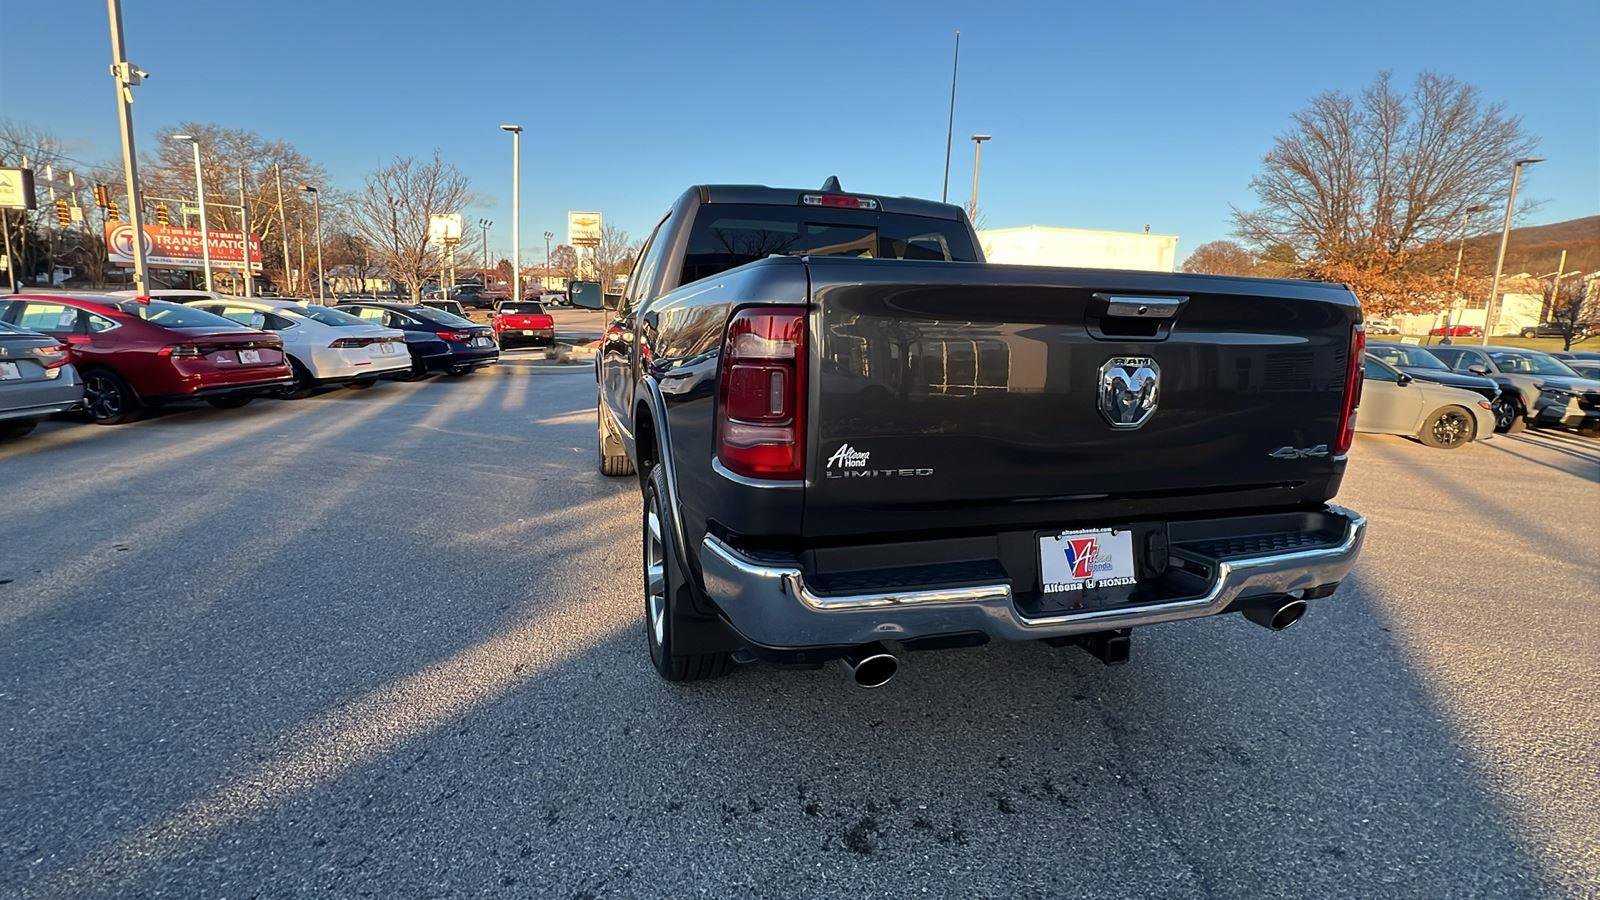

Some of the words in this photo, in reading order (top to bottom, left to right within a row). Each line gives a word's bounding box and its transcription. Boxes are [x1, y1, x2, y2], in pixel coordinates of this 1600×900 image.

[193, 246, 258, 257] CURCH
[826, 443, 870, 468] Altoona
[826, 468, 934, 479] LIMITED
[1044, 582, 1083, 594] Altoona
[1099, 577, 1137, 588] HONDA
